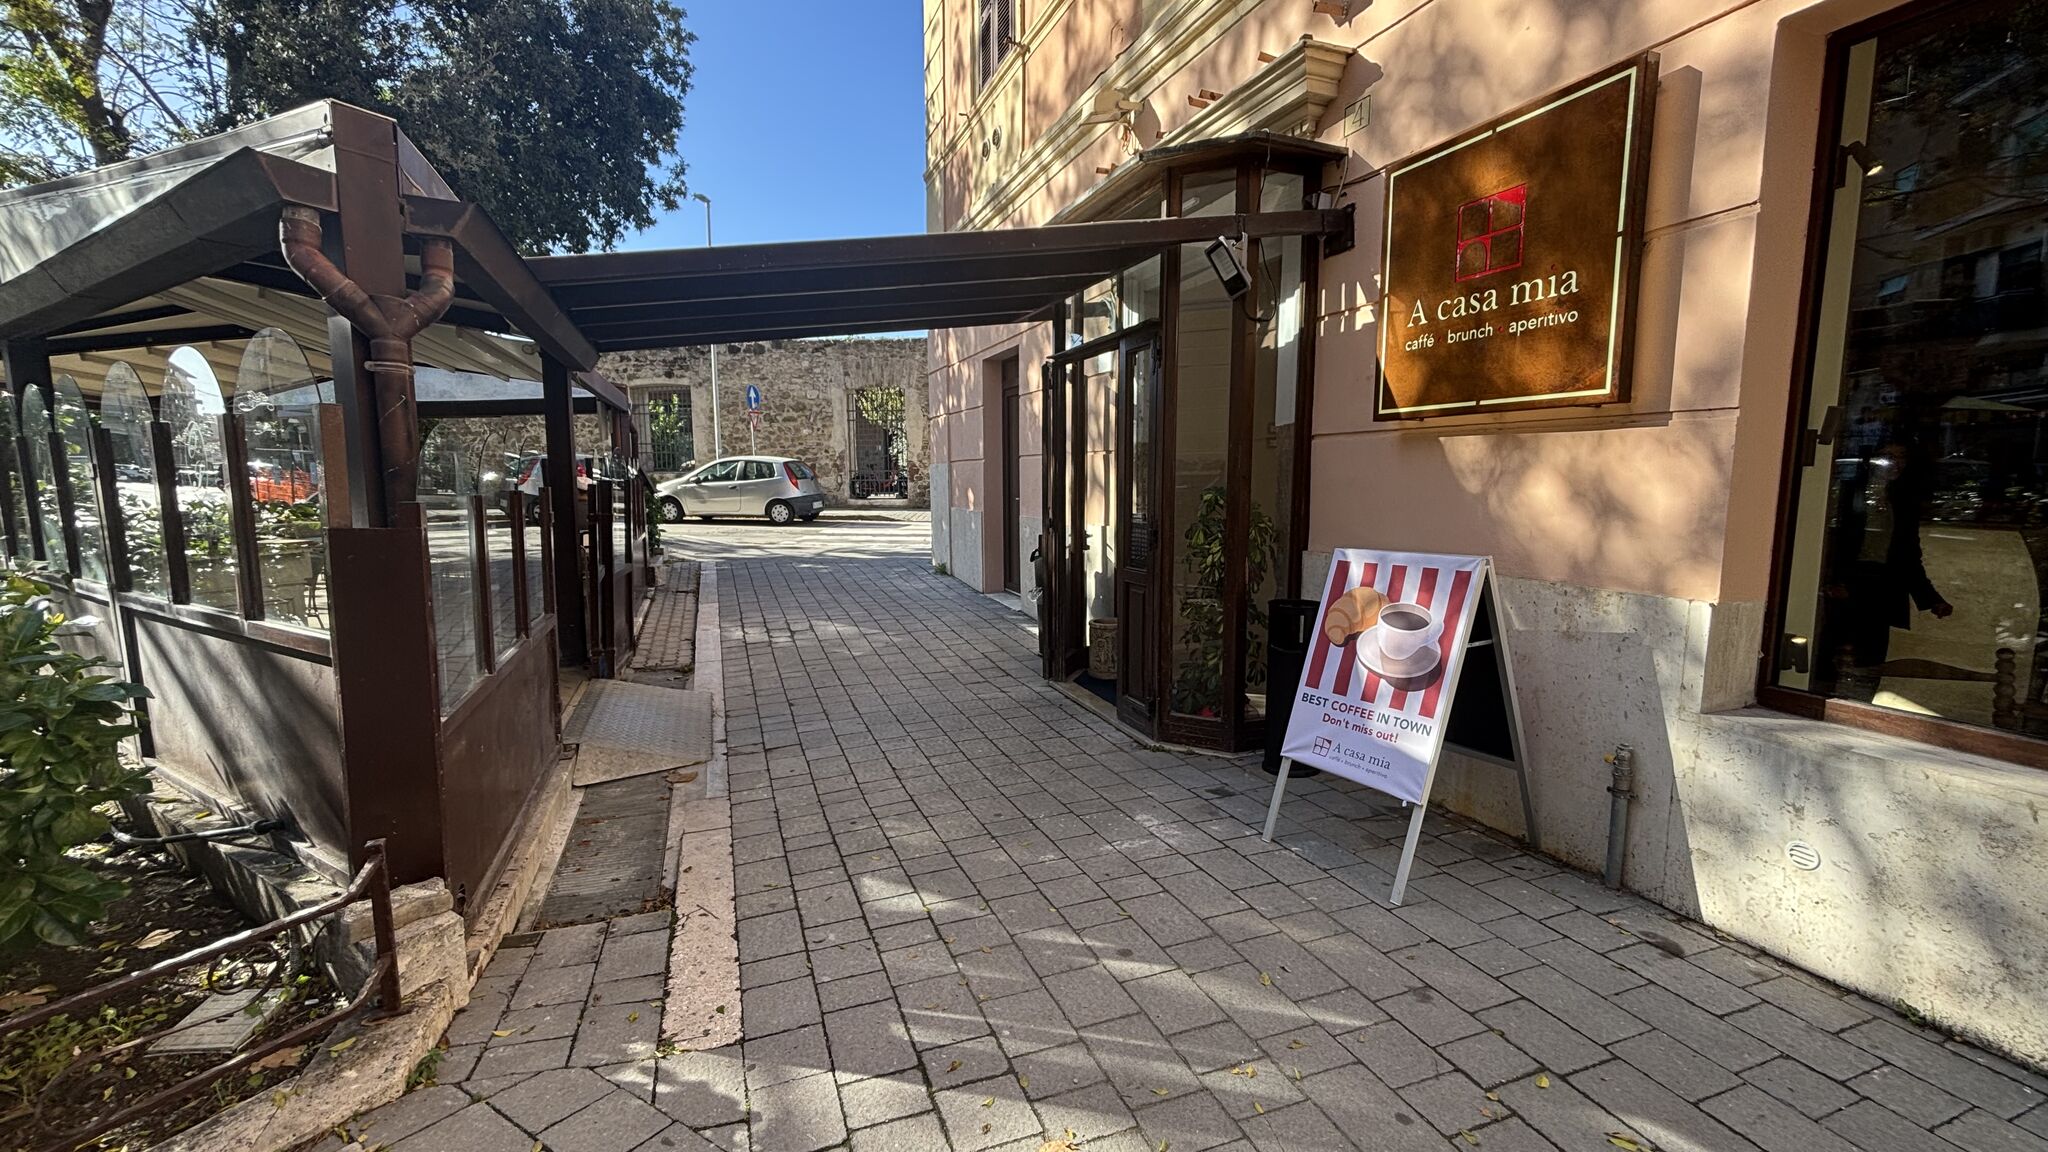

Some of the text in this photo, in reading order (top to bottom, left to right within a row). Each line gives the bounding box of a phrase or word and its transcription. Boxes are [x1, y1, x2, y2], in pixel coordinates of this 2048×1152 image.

[1352, 102, 1364, 126] 4
[1407, 264, 1580, 328] A casa mia
[1405, 310, 1579, 351] caffé brunch aperitivo
[1301, 692, 1433, 737] BEST COFFEE IN TOWN
[1322, 713, 1399, 743] Don't miss out!
[1333, 742, 1341, 754] A
[1343, 748, 1366, 761] casa
[1368, 755, 1391, 770] mia
